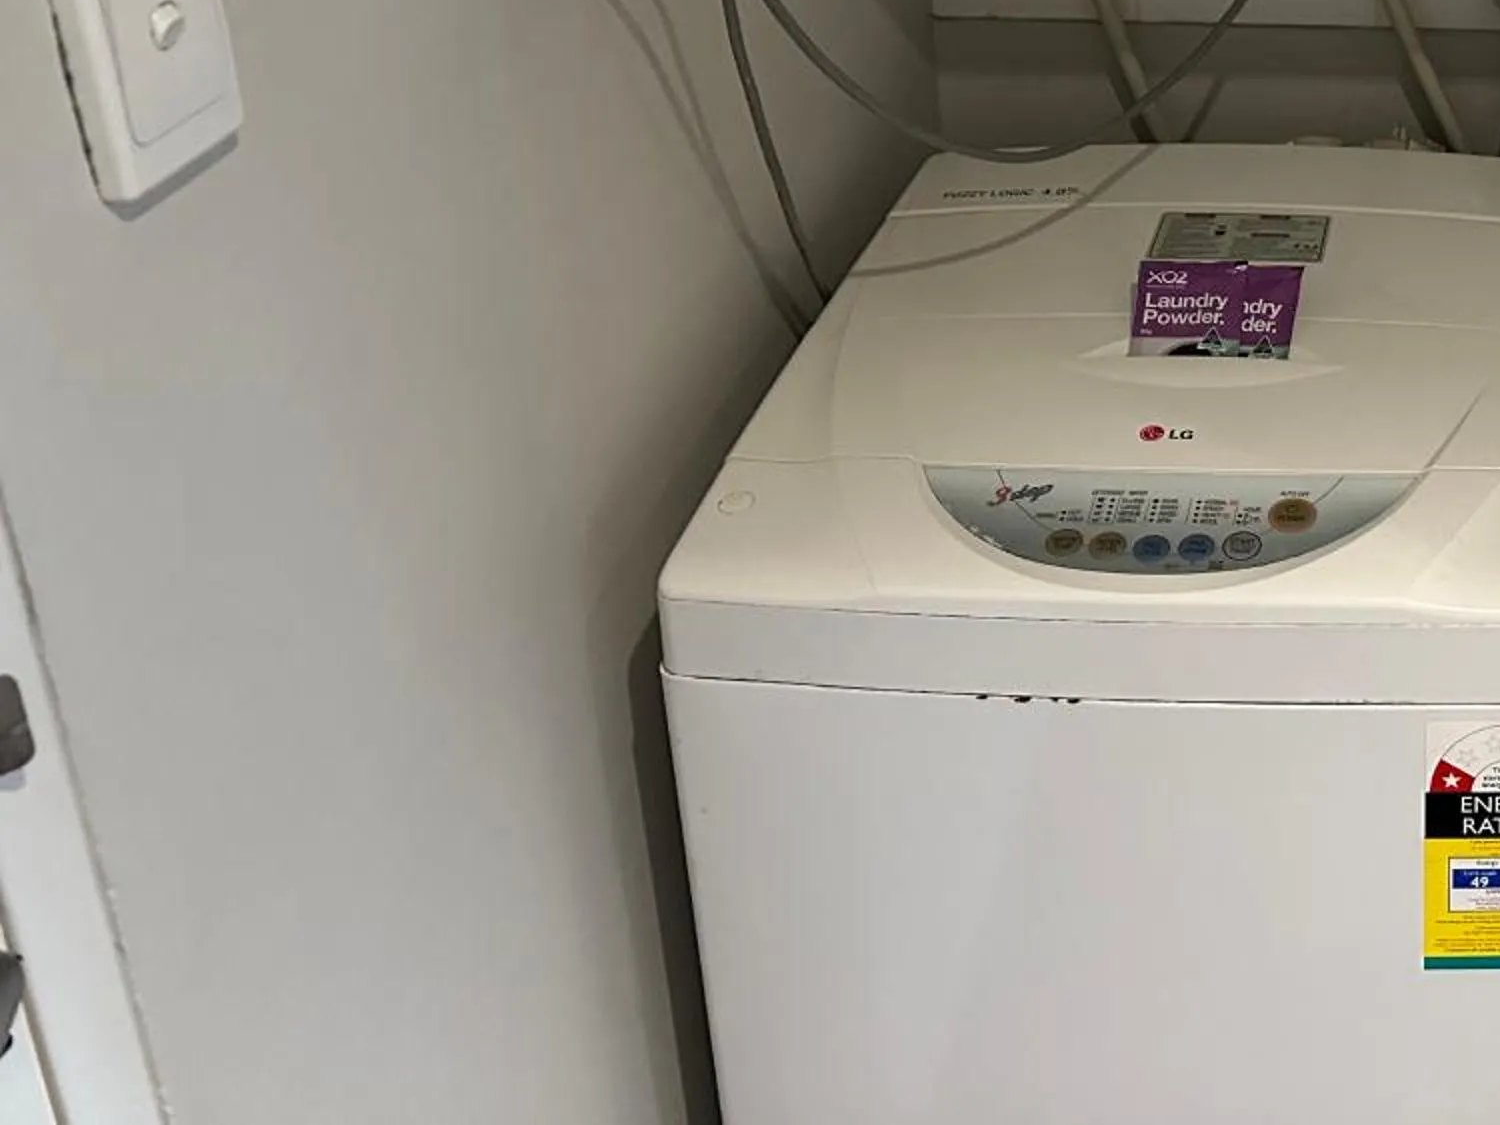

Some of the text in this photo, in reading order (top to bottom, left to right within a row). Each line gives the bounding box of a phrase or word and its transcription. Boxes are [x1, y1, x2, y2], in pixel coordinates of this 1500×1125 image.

[1146, 270, 1188, 285] XO2
[1145, 291, 1229, 310] Laundry
[1143, 309, 1225, 326] Powder.
[1168, 428, 1194, 440] LG
[1470, 876, 1489, 888] 49
